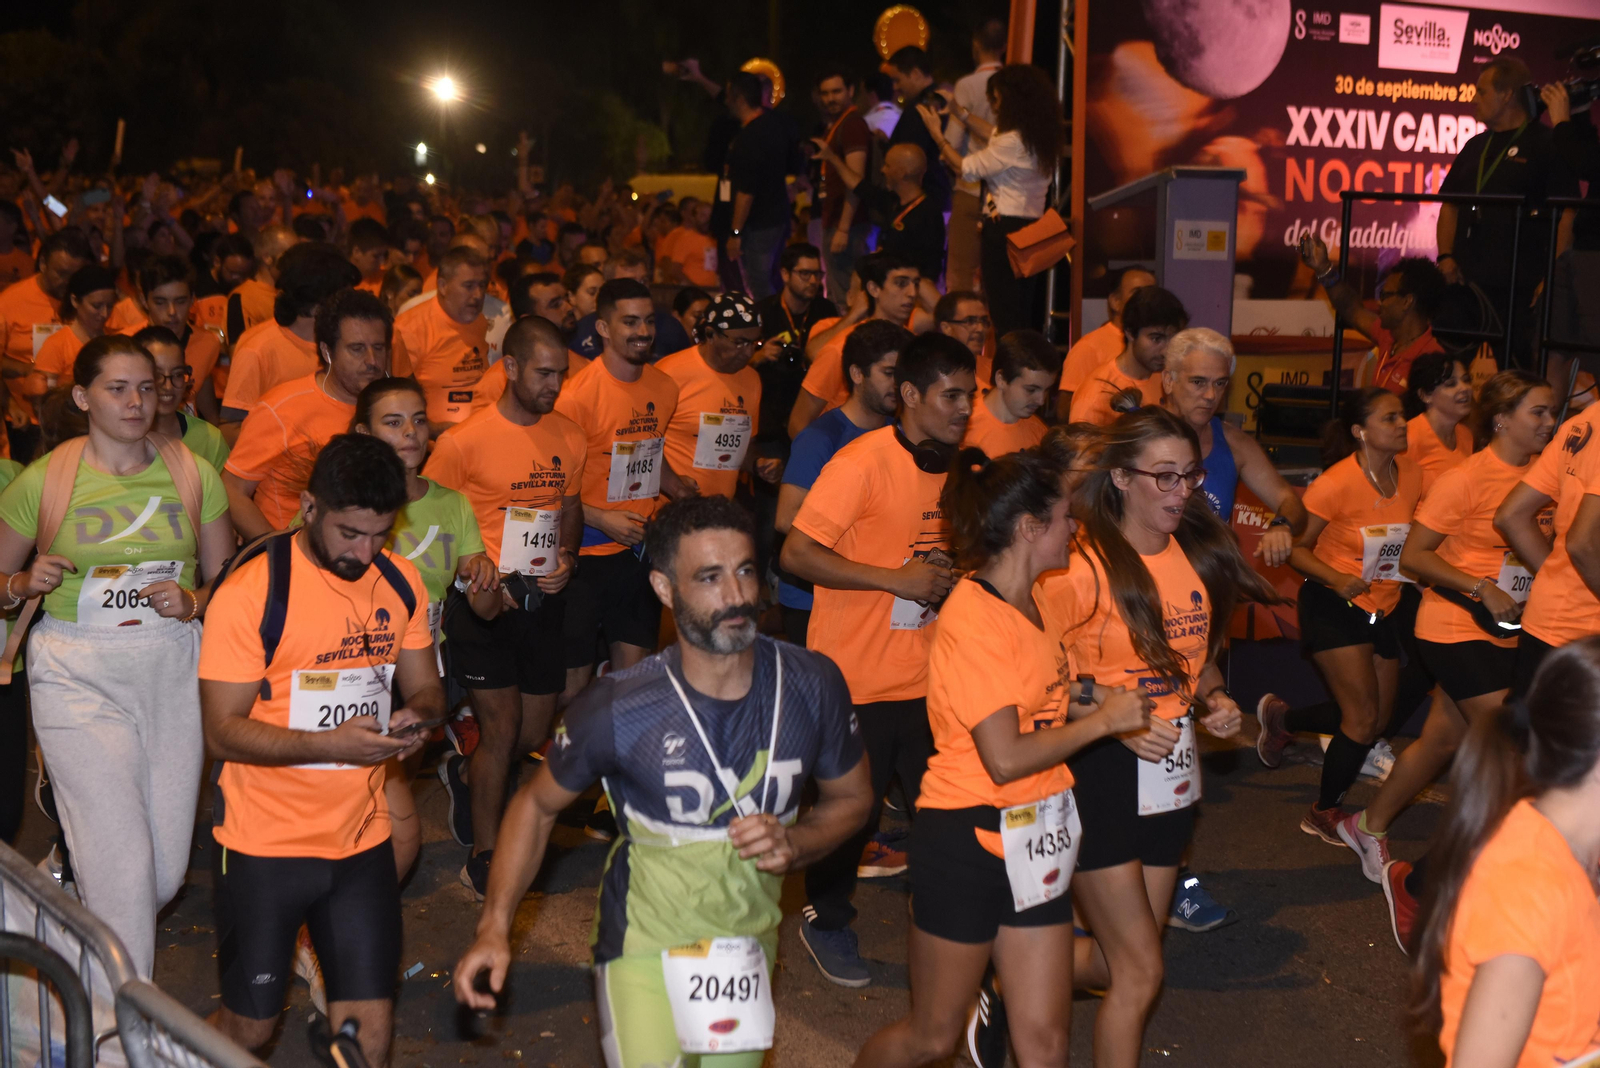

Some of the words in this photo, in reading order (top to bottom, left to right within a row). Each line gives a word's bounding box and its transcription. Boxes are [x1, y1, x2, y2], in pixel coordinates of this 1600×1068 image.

[1335, 75, 1353, 95] 30
[1355, 77, 1375, 96] de
[1376, 79, 1458, 103] septiembre
[1286, 105, 1391, 150] XXXIV
[1393, 112, 1487, 155] CARR
[1285, 157, 1451, 206] NOCTU
[715, 433, 742, 448] 4935
[529, 472, 566, 480] NOCTURNA
[626, 458, 654, 477] 14185
[510, 480, 547, 491] SEVILLA
[75, 496, 184, 544] DXT
[1379, 544, 1402, 557] 668
[315, 646, 365, 665] SEVILLA
[317, 700, 379, 728] 20299
[1025, 826, 1072, 862] 14353
[688, 972, 760, 1003] 20497
